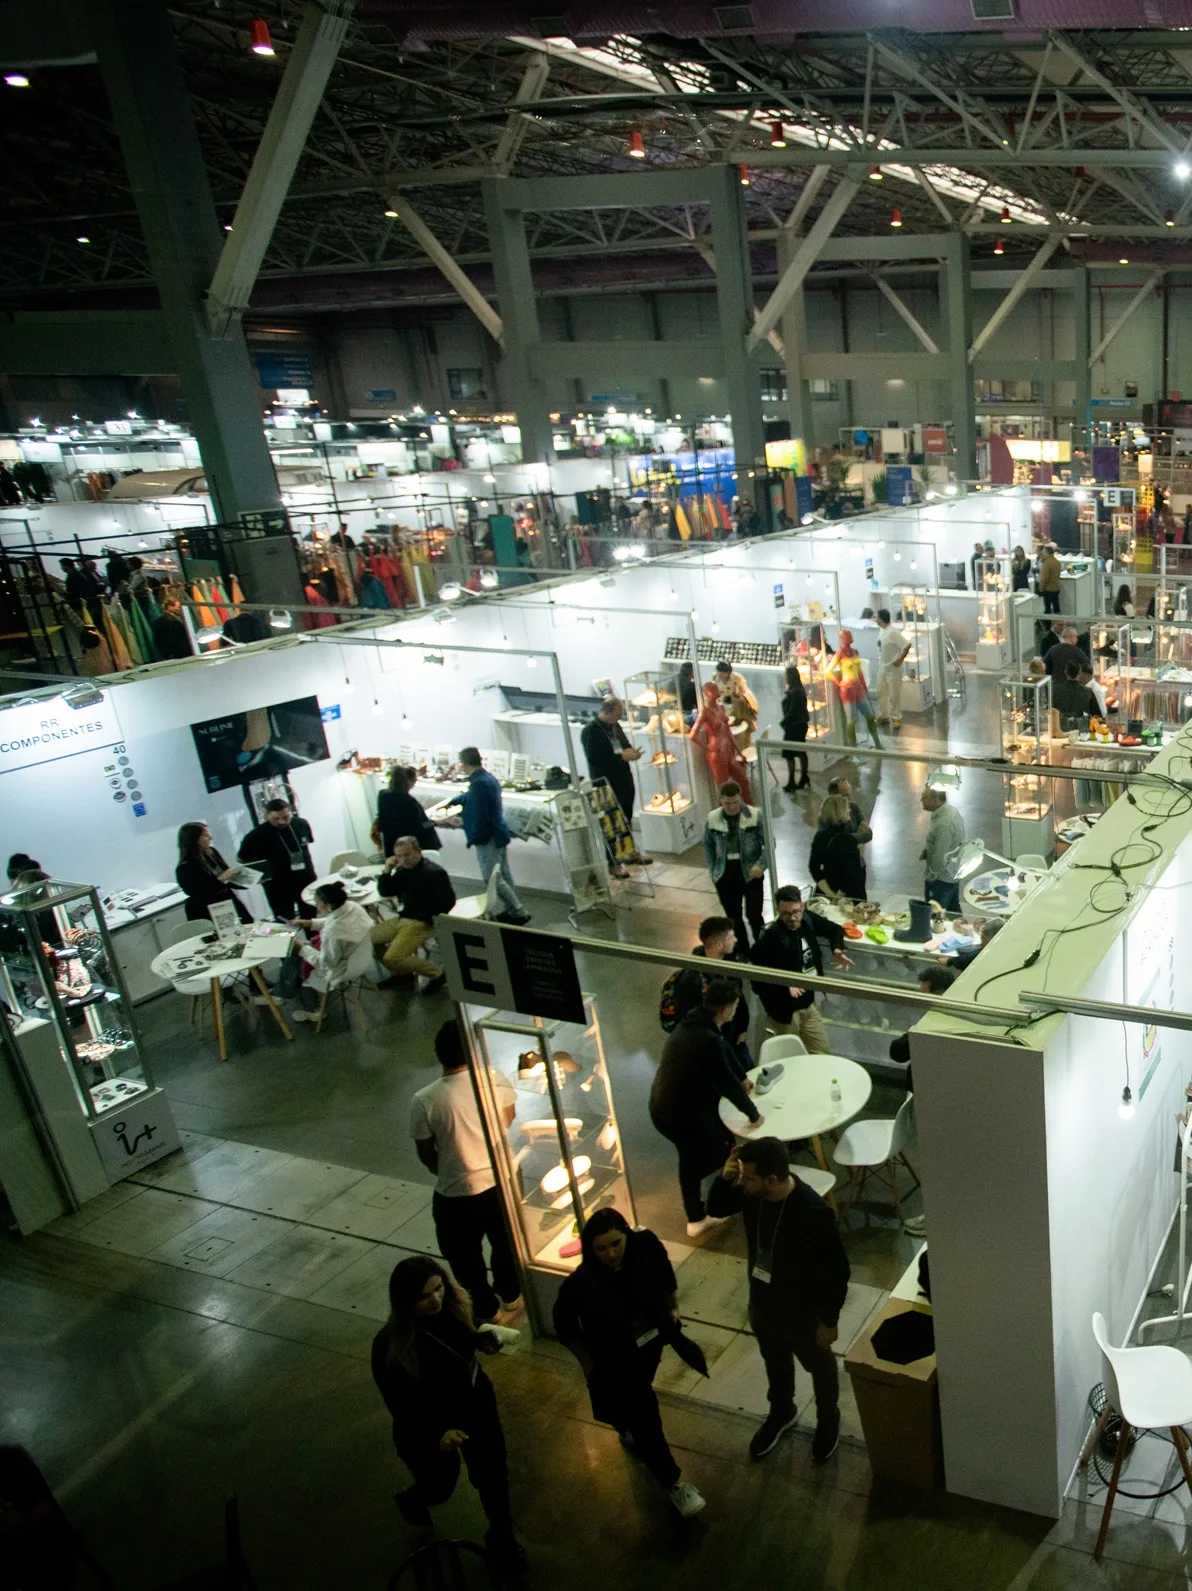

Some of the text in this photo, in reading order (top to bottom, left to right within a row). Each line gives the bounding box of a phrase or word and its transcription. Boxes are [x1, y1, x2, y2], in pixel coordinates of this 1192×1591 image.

[1108, 491, 1116, 504] E
[40, 718, 60, 730] RR
[0, 720, 103, 753] COMPONENTES
[113, 745, 127, 755] 40
[453, 931, 496, 995] E
